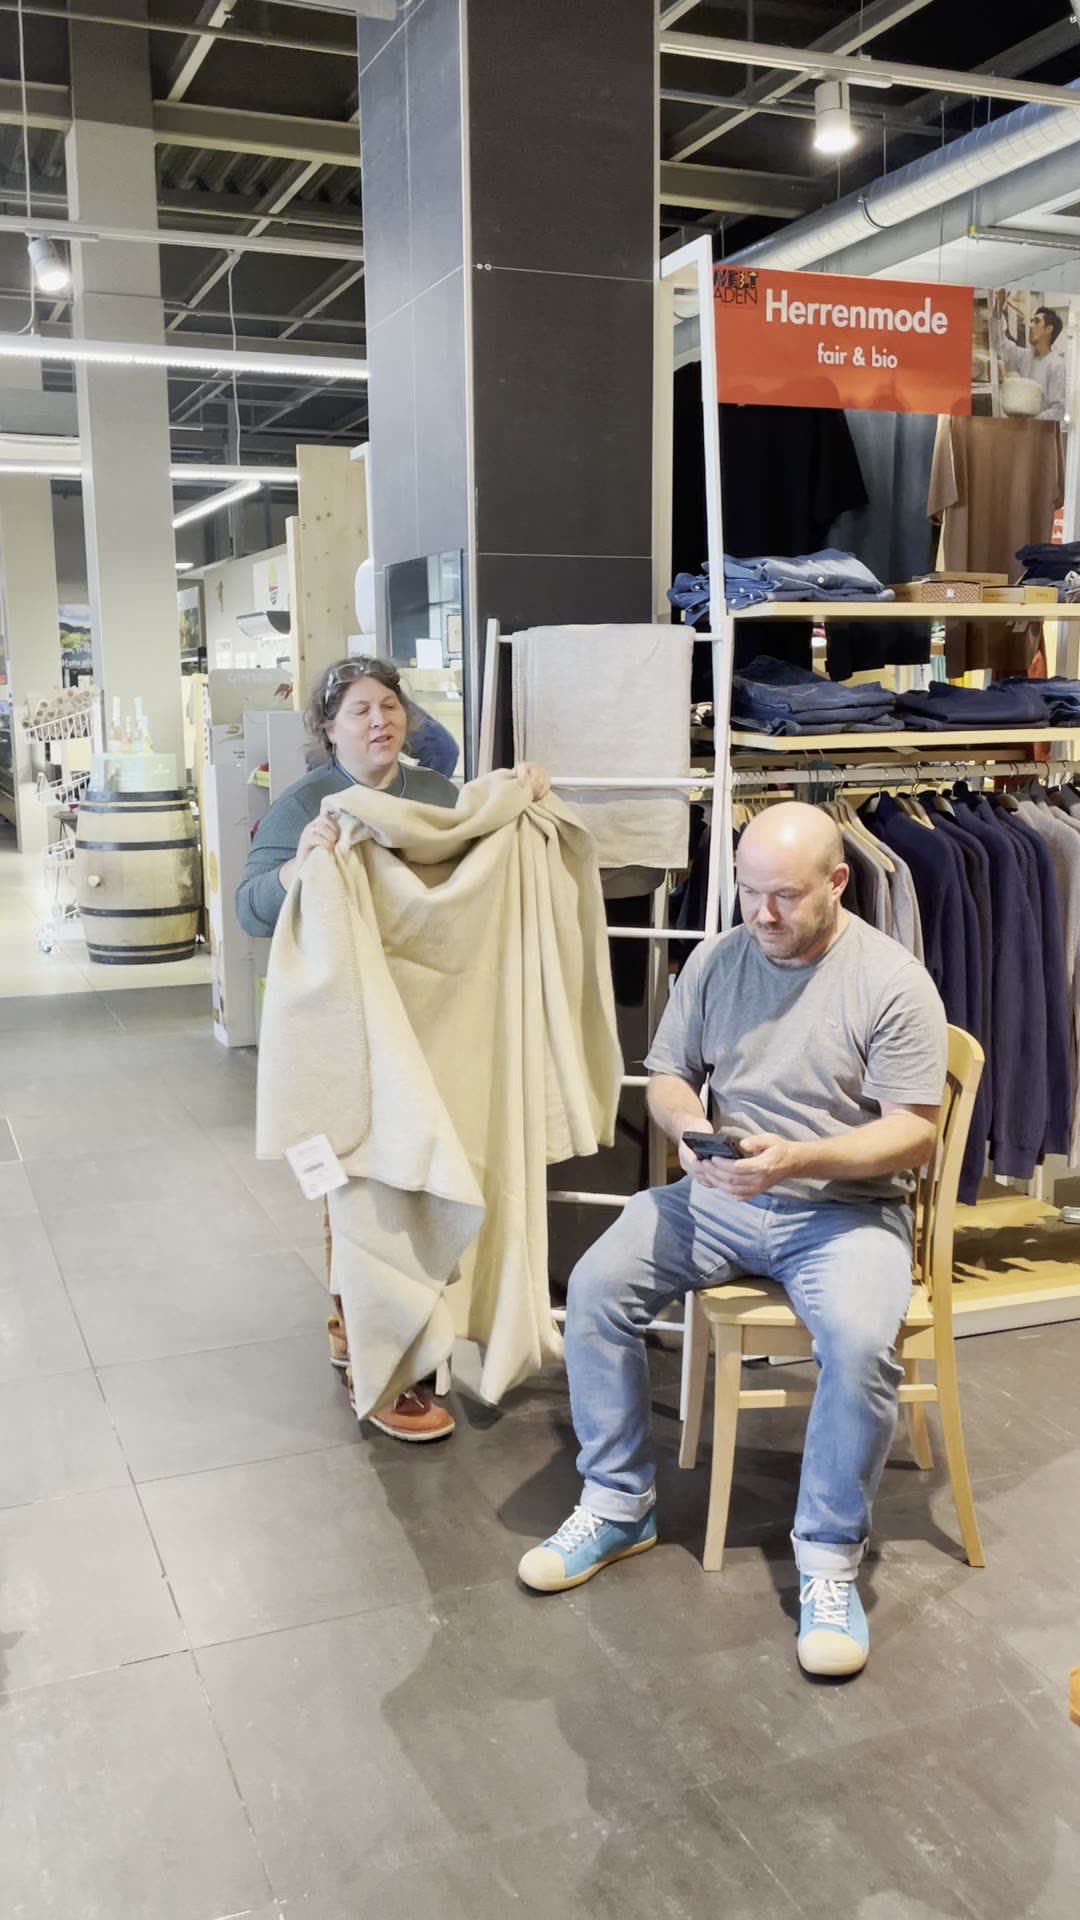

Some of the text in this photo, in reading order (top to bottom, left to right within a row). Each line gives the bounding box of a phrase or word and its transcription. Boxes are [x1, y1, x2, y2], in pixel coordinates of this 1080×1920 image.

[713, 286, 758, 304] ADEN
[765, 288, 948, 335] Herrenmode
[817, 341, 898, 369] fair & bio
